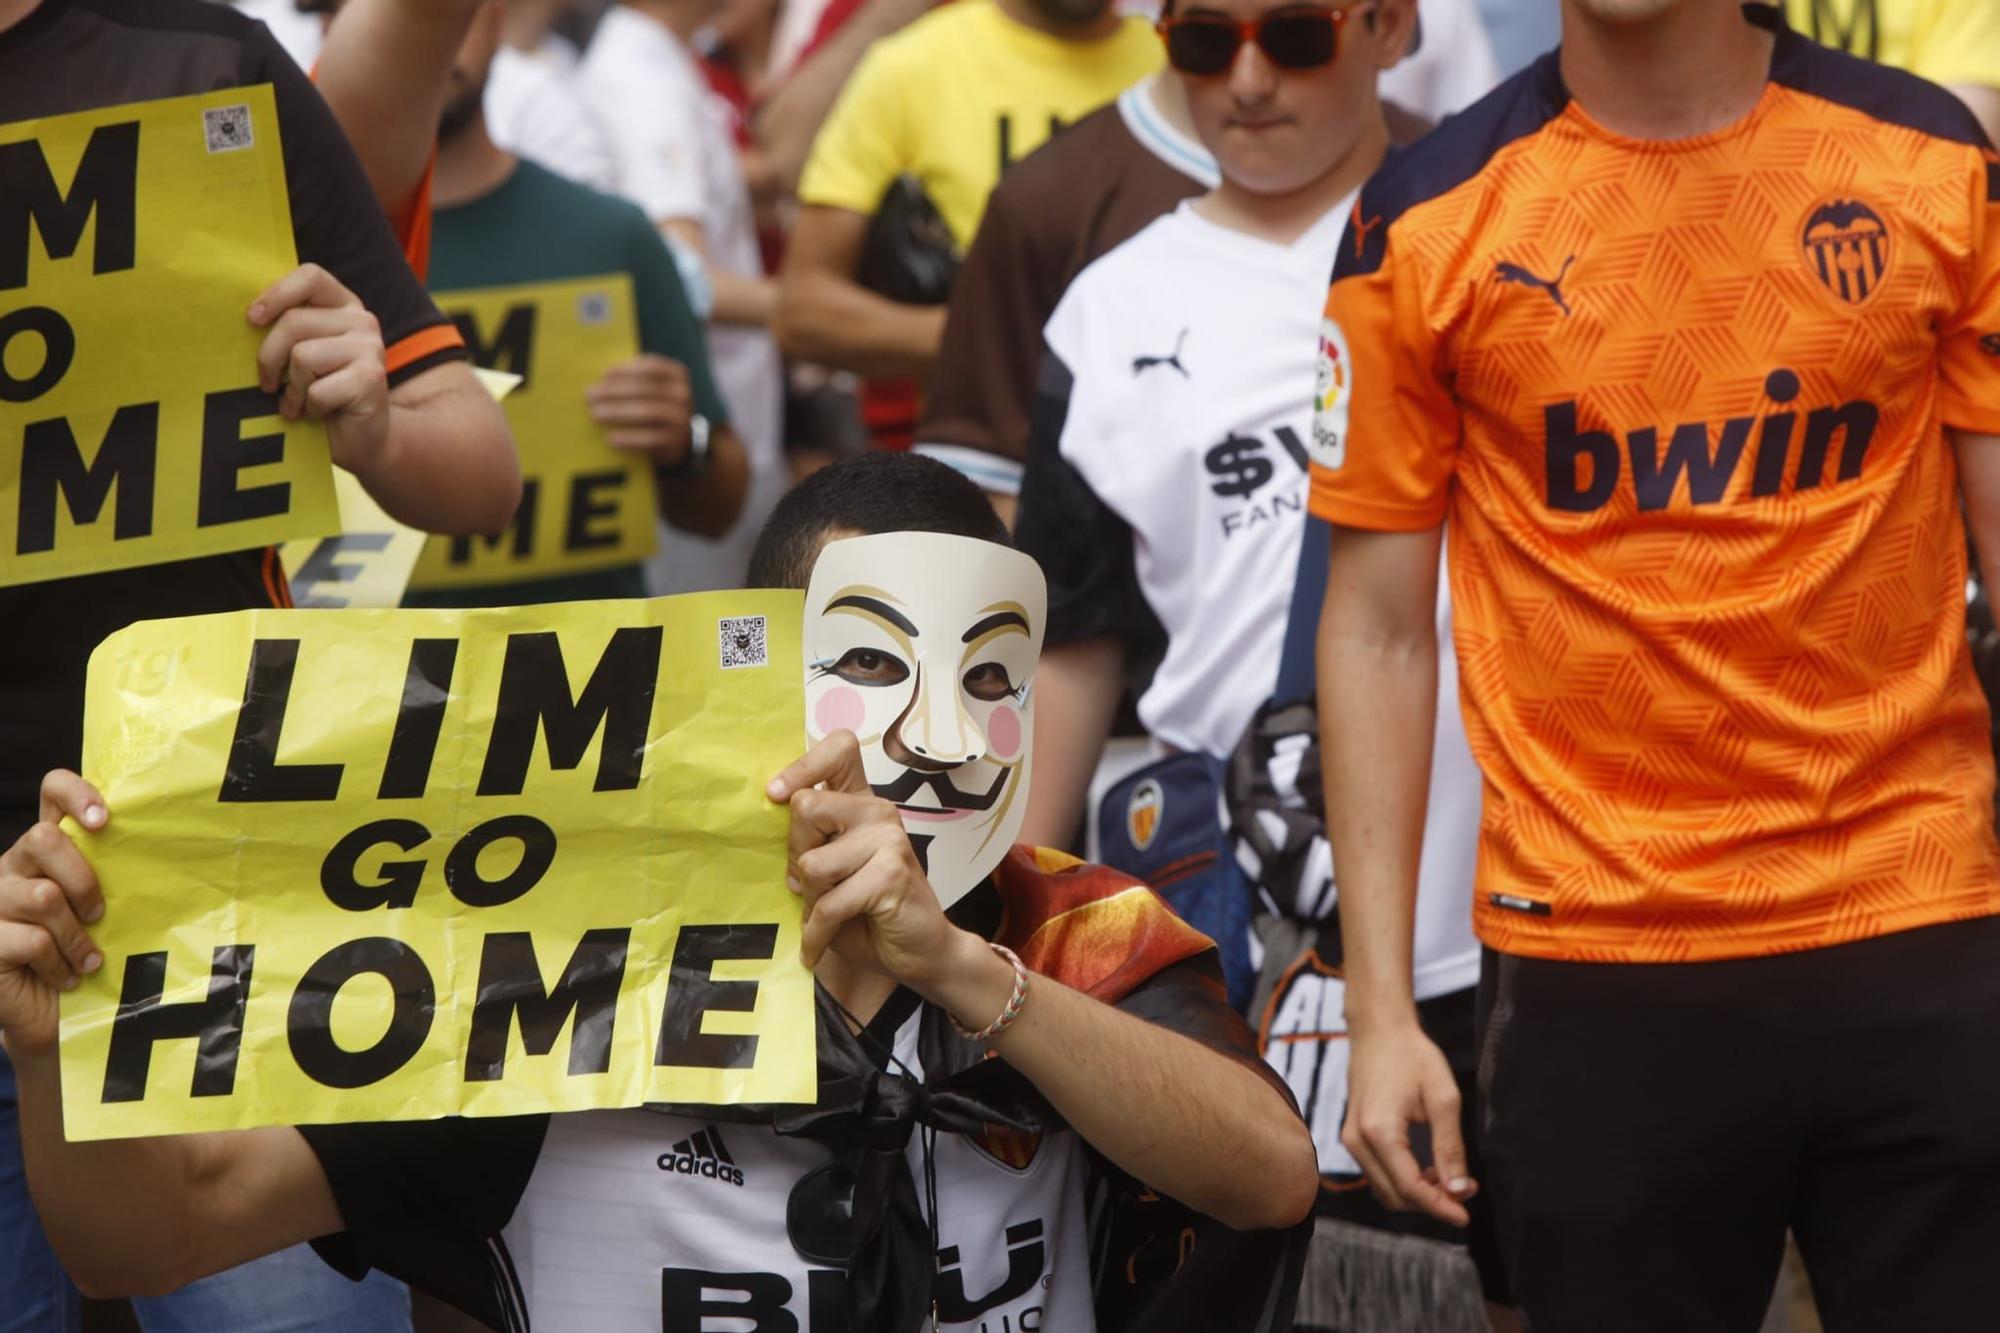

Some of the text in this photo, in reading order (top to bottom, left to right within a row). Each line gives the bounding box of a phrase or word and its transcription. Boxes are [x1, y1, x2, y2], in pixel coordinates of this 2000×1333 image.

[1543, 368, 1879, 513] bwin
[218, 625, 664, 804] LIM
[320, 814, 557, 912] GO
[100, 922, 780, 1105] HOME
[656, 1152, 744, 1188] adidas
